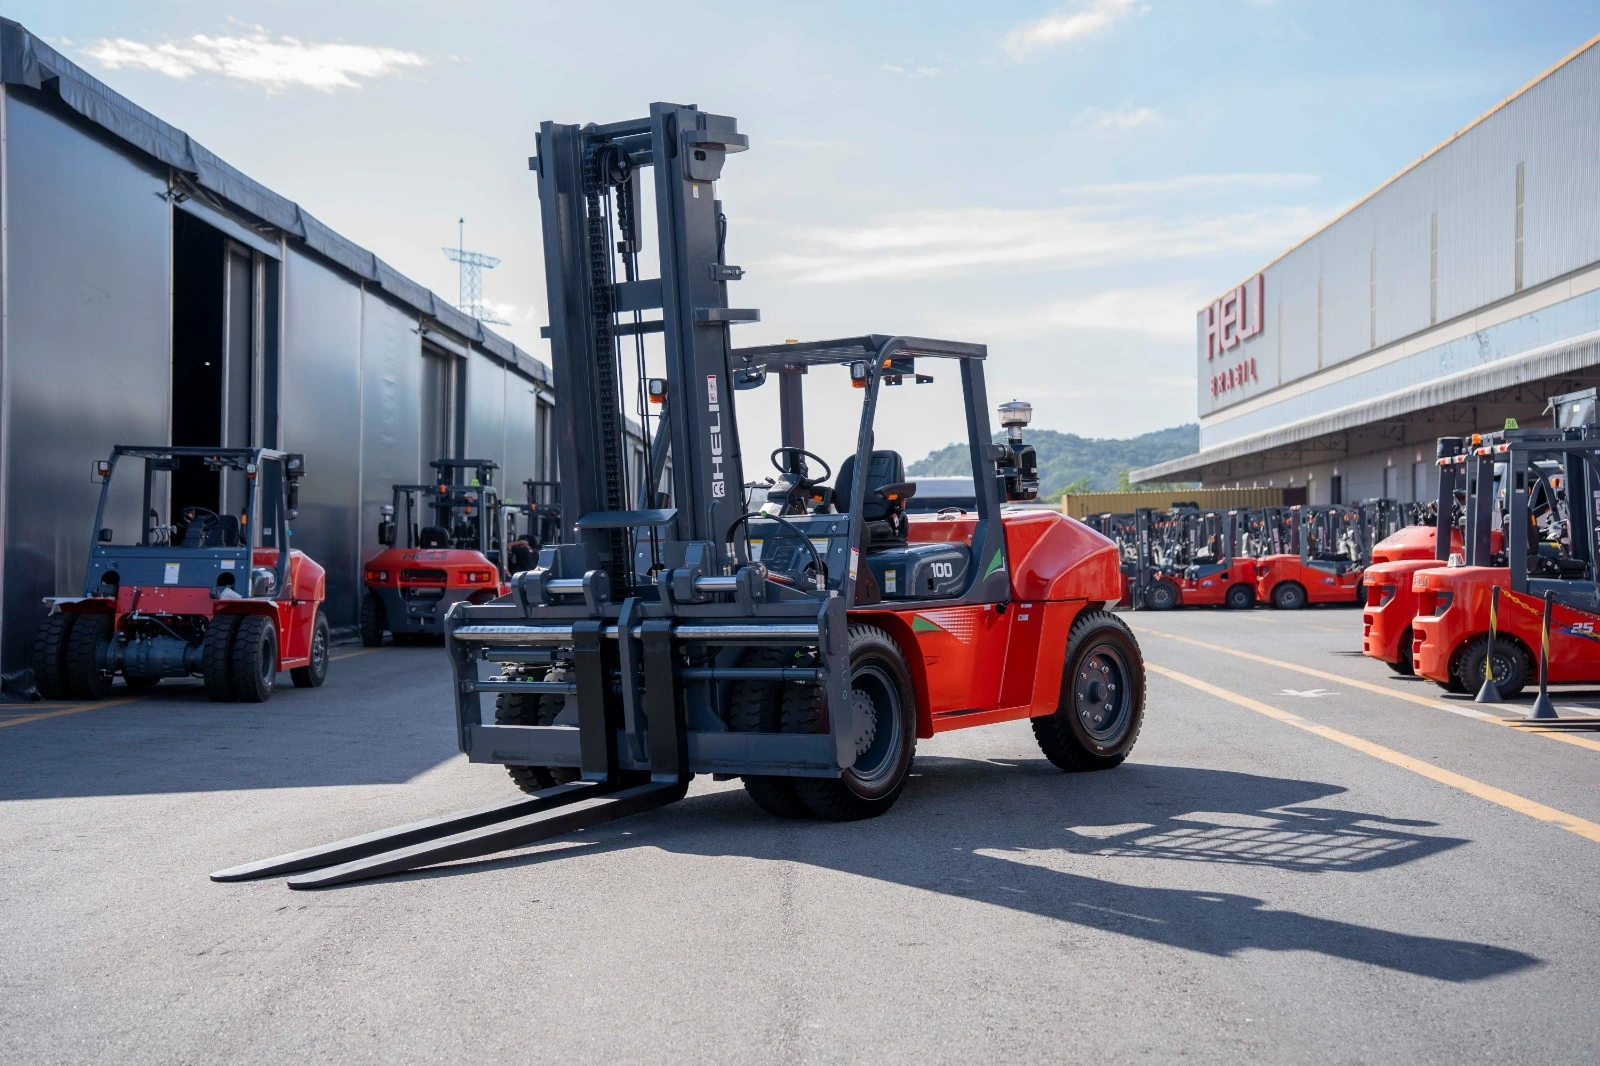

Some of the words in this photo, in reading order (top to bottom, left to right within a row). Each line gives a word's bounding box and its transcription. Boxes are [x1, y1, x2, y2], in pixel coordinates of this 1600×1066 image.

[1204, 272, 1264, 360] HELI
[1211, 357, 1257, 397] BRASIL
[708, 403, 724, 480] HELI
[713, 483, 724, 496] CE
[930, 562, 953, 578] 100
[1570, 622, 1594, 634] 25
